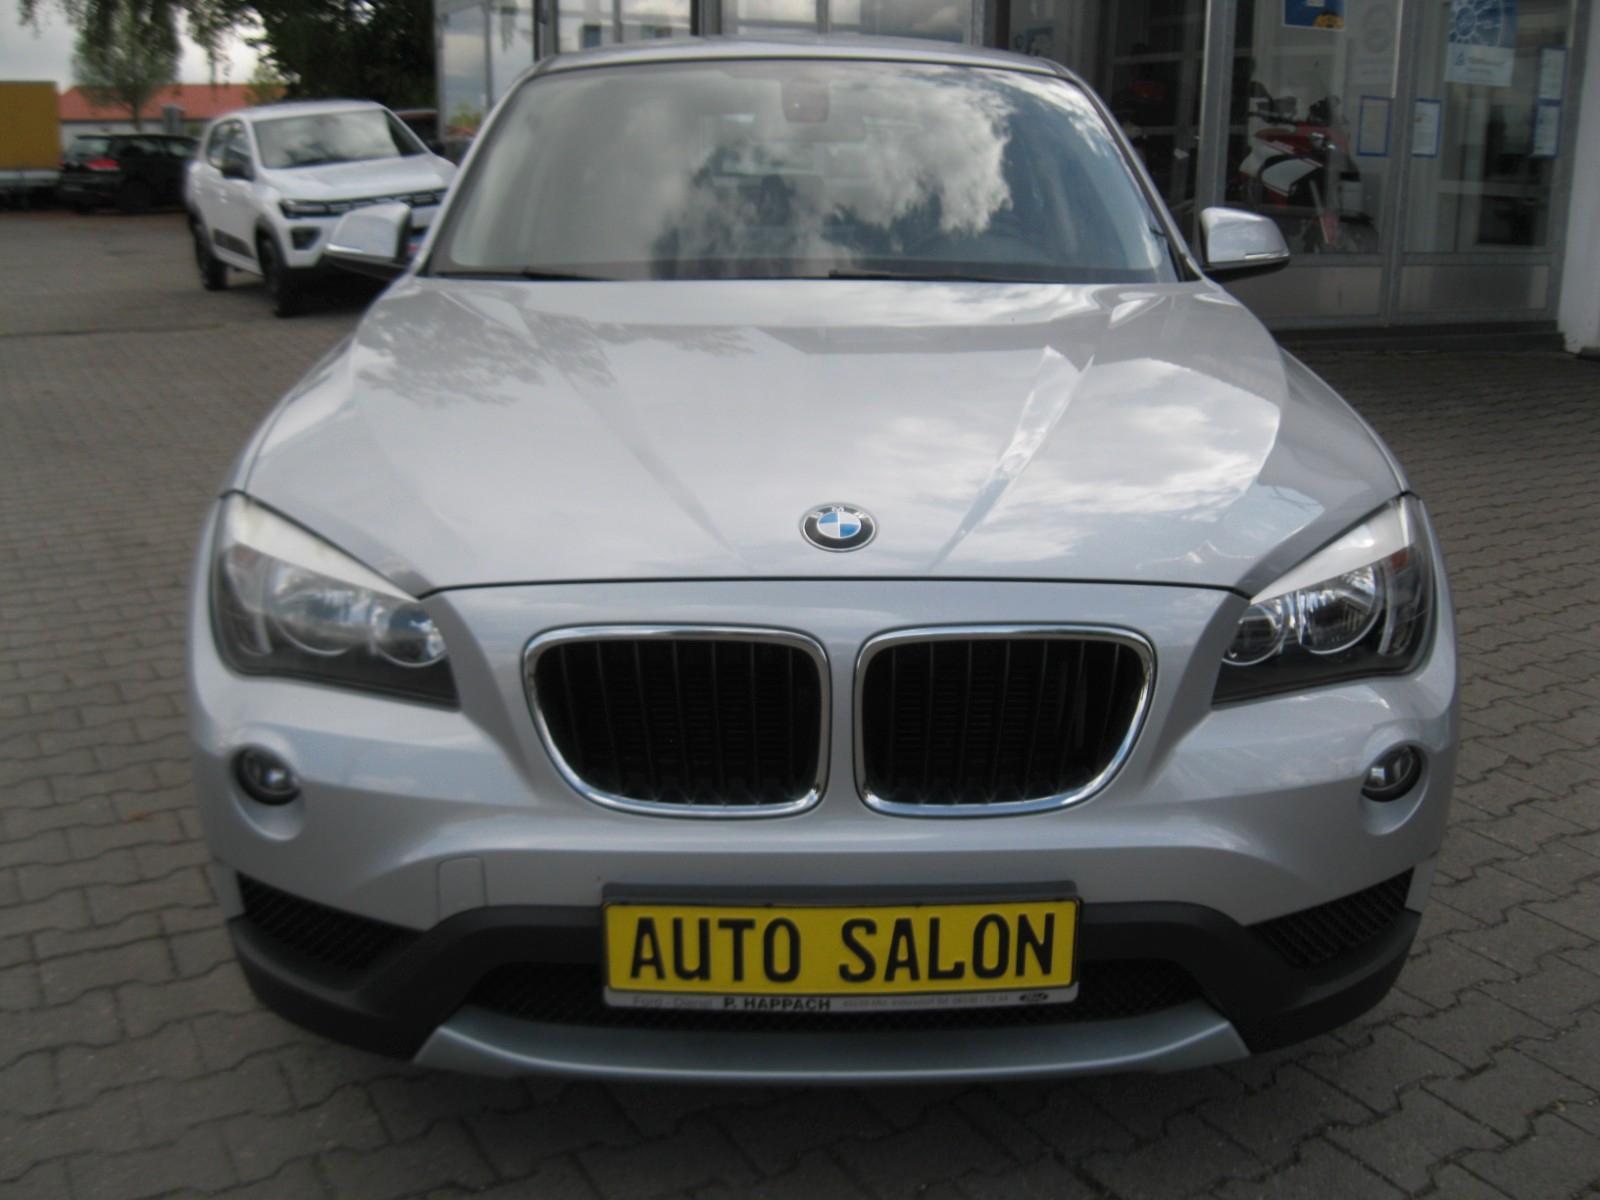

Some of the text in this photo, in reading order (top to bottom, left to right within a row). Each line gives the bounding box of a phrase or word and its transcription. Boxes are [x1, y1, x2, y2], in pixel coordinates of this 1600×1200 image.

[630, 912, 1056, 984] AUTO SALON
[723, 996, 738, 1009] P.
[744, 996, 831, 1011] HAPPACH
